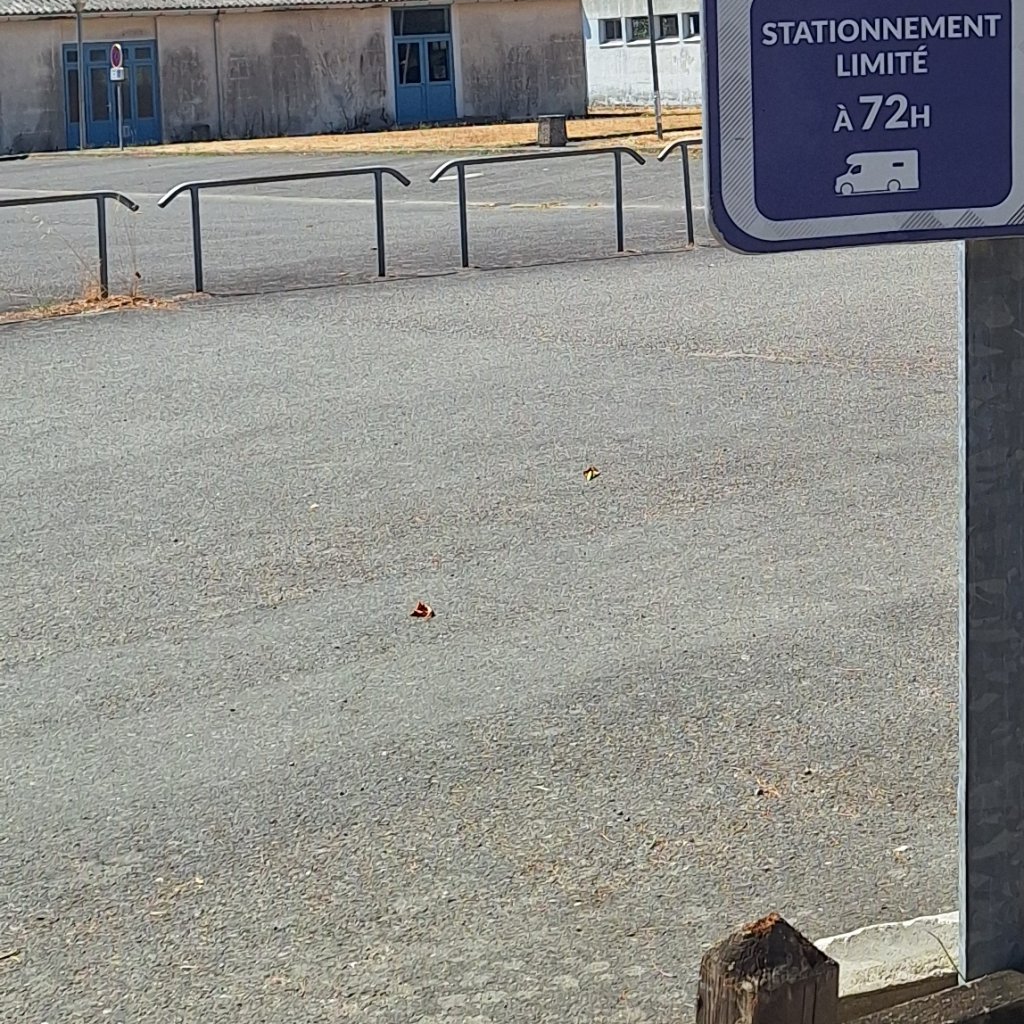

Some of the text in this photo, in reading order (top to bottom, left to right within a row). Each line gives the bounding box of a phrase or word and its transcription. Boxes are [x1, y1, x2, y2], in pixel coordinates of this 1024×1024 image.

[760, 14, 1002, 46] STATIONNEMENT
[836, 45, 929, 77] LIMITÉ
[833, 105, 854, 132] À
